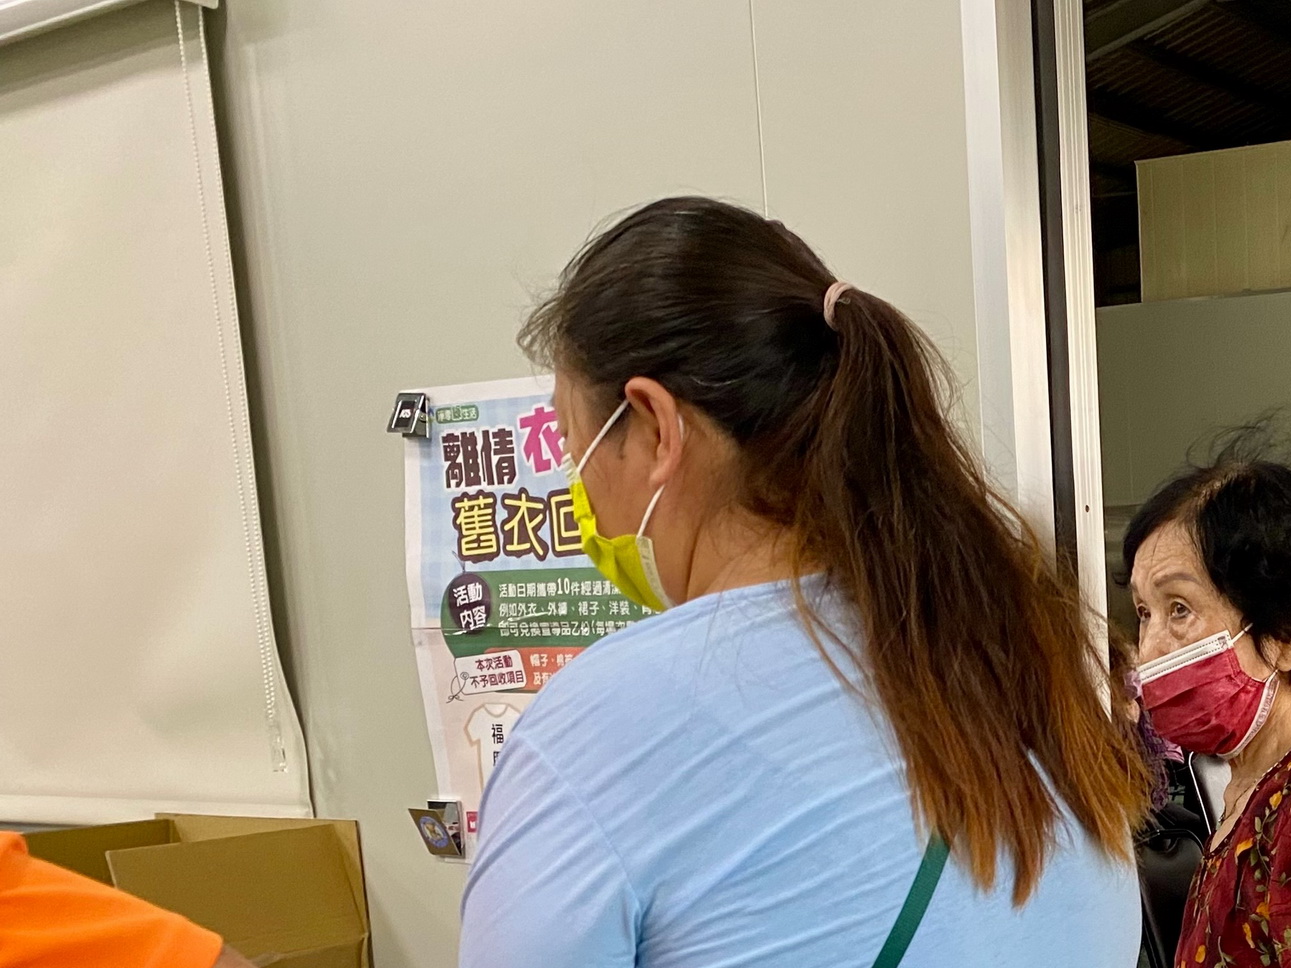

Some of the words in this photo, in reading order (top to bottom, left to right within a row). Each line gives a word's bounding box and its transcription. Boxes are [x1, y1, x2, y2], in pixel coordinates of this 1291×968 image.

[453, 582, 483, 606] 活動
[460, 606, 487, 629] 內容
[475, 655, 513, 672] 本次活動
[470, 670, 524, 688] 不予回收項目
[491, 724, 504, 744] 福
